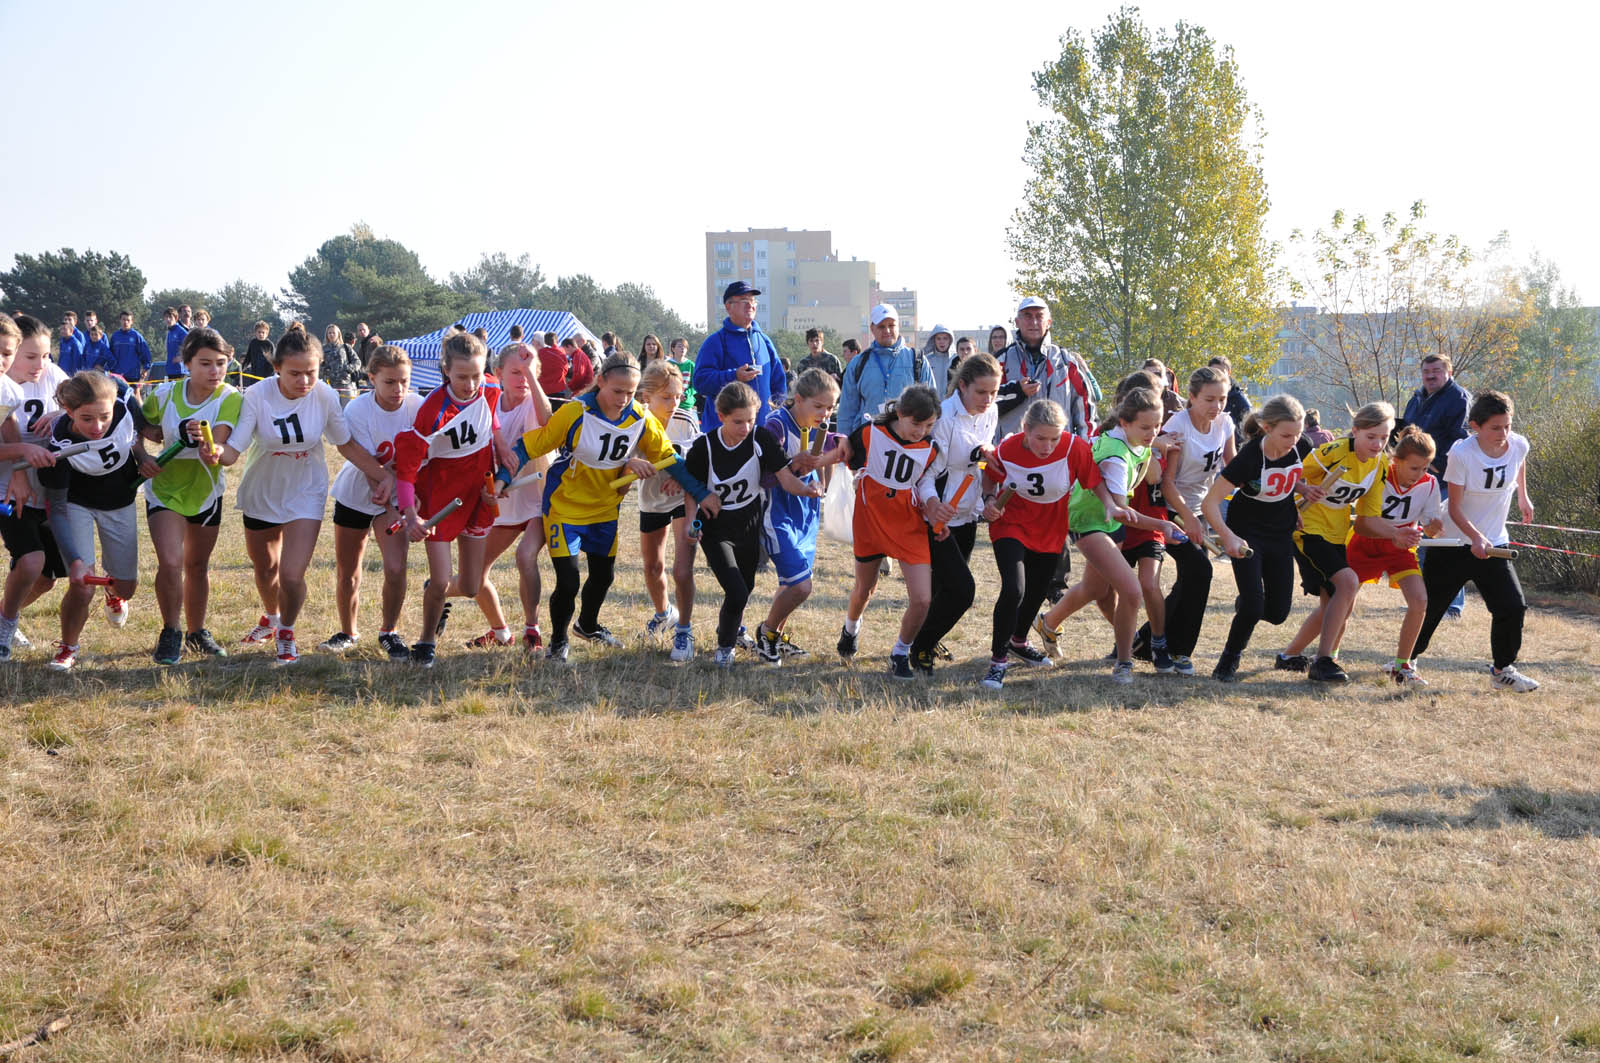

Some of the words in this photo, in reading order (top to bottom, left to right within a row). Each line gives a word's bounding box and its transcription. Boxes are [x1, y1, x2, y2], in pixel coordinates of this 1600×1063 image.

[24, 399, 44, 432] 2
[273, 413, 304, 444] 11
[445, 420, 477, 449] 14
[597, 433, 629, 461] 16
[98, 443, 120, 469] 5
[884, 450, 914, 483] 10
[1027, 473, 1045, 497] 3
[1264, 467, 1302, 497] 30
[1482, 465, 1508, 489] 17
[714, 479, 753, 505] 22
[1326, 486, 1366, 504] 20
[1381, 495, 1412, 520] 21
[550, 523, 559, 549] 2
